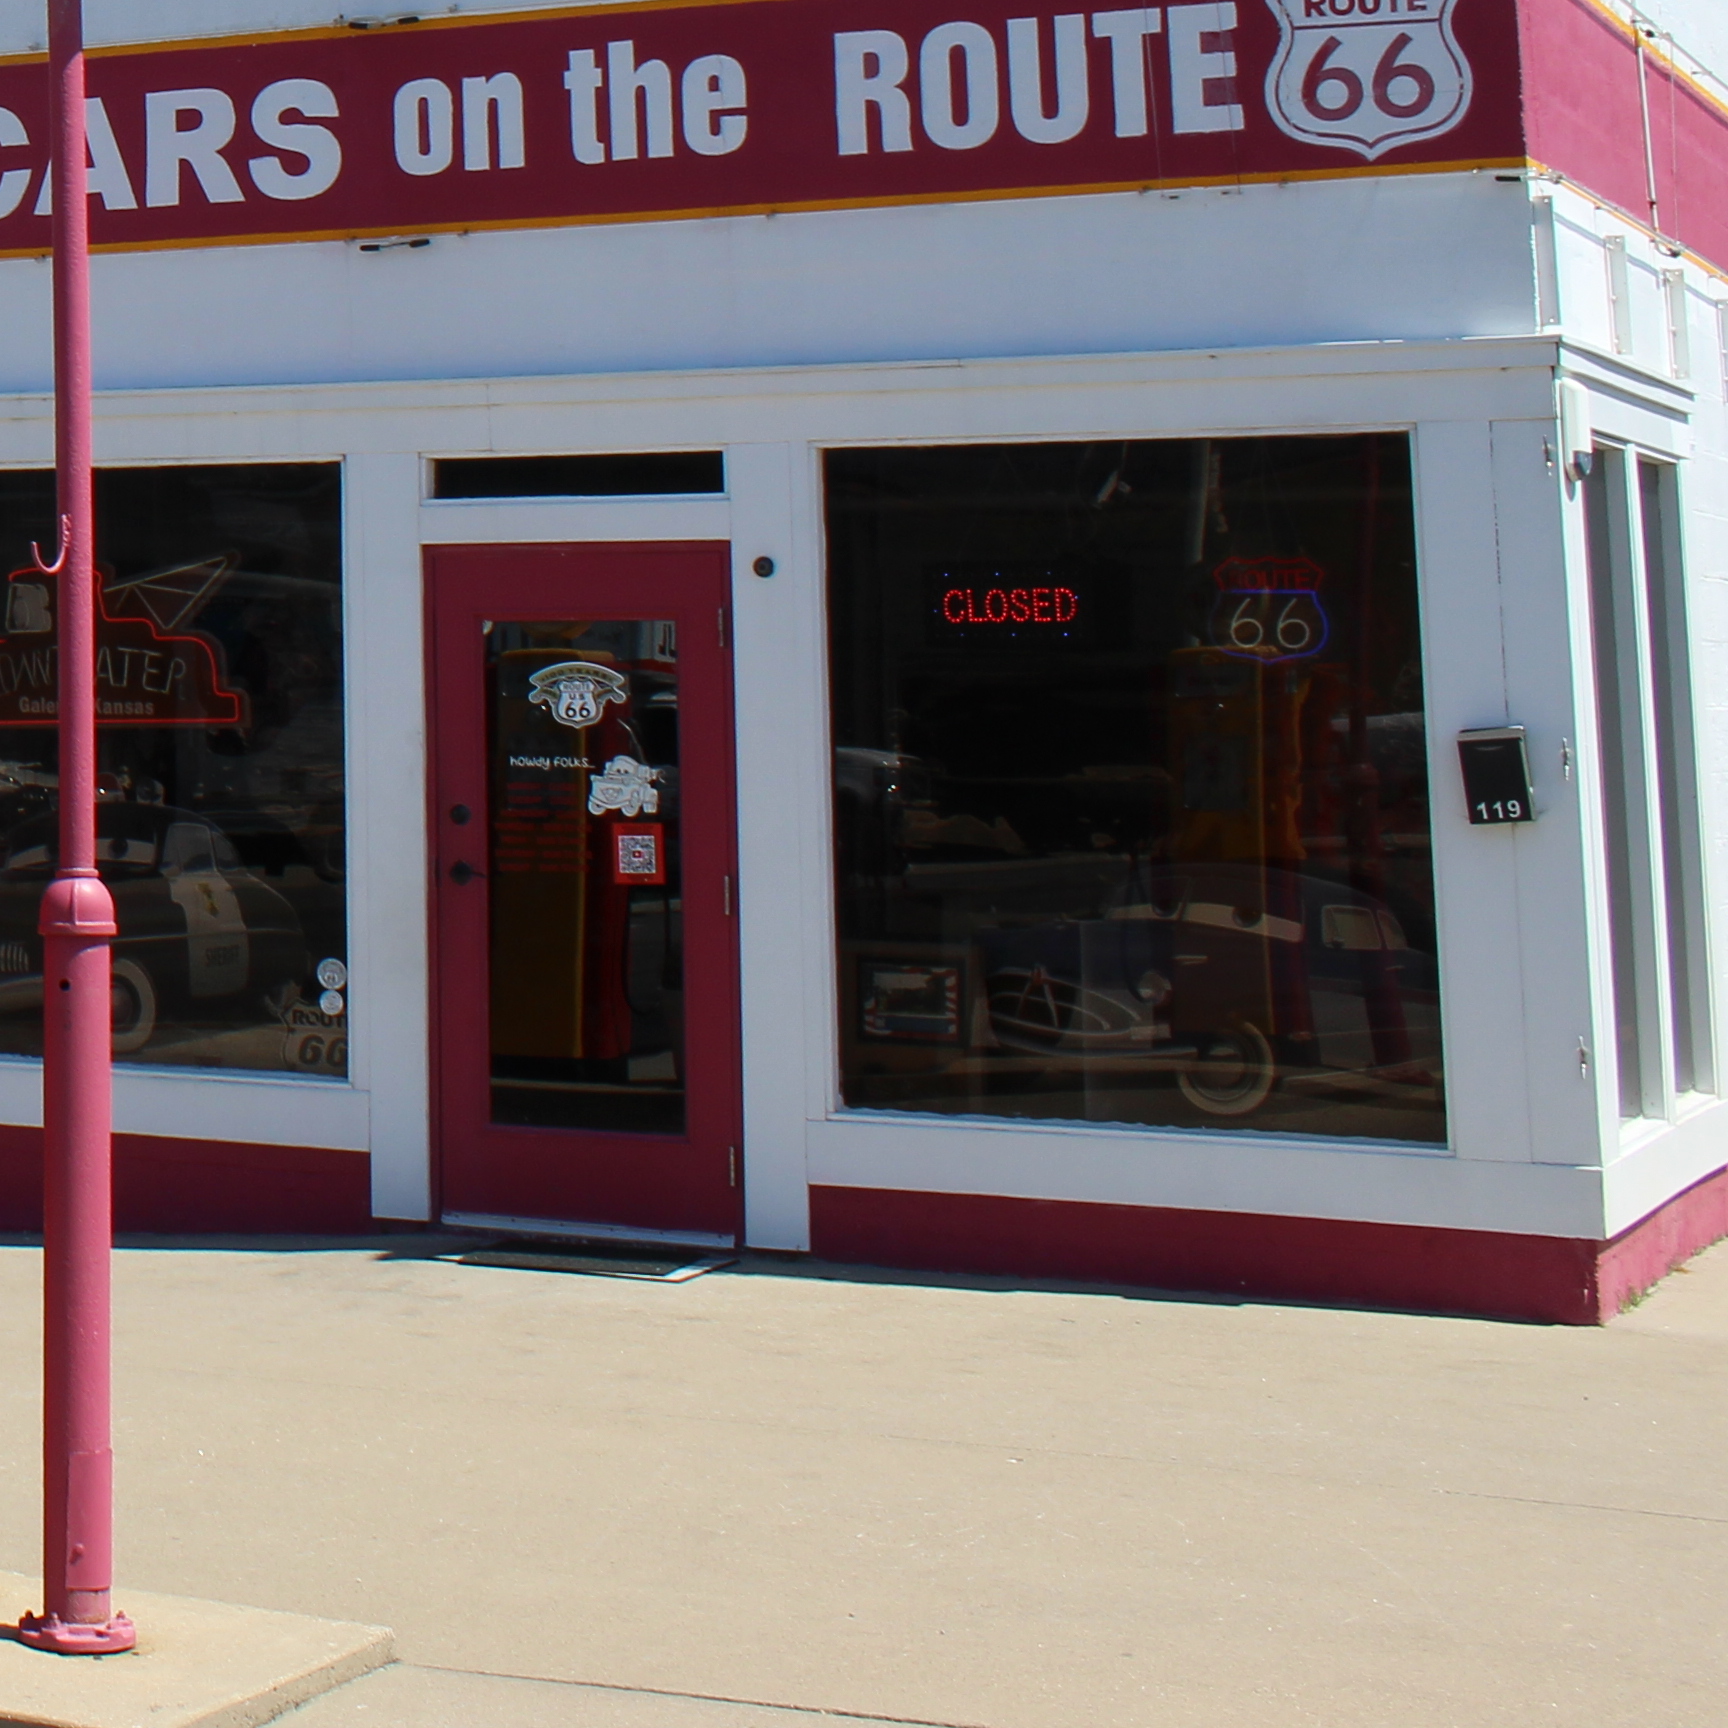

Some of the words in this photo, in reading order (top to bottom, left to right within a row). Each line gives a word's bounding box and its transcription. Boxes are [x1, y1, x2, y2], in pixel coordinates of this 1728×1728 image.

[393, 71, 526, 177] on
[563, 39, 748, 166] the
[833, 0, 1245, 158] ROUTE
[1301, 33, 1436, 122] 66
[943, 587, 1077, 623] CLOSED
[1229, 598, 1311, 649] 66
[82, 645, 187, 700] ATER
[564, 701, 591, 718] 66
[1472, 799, 1522, 820] 119
